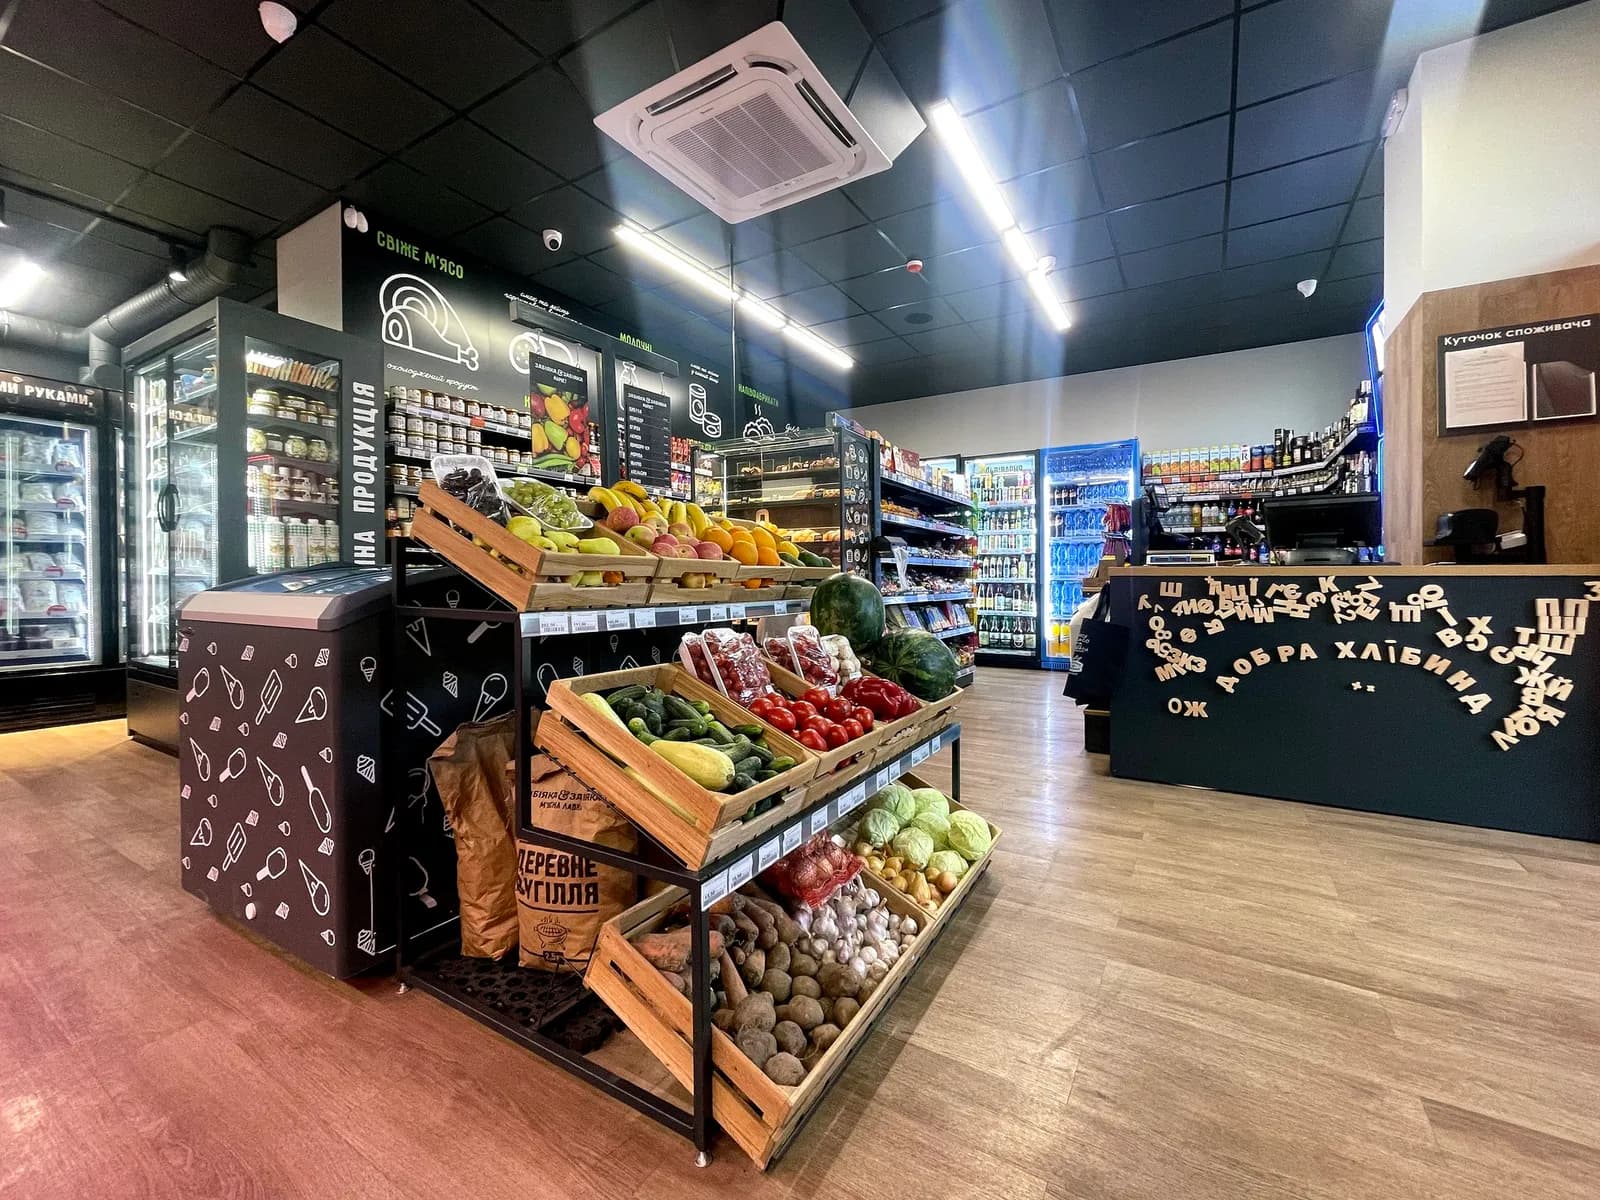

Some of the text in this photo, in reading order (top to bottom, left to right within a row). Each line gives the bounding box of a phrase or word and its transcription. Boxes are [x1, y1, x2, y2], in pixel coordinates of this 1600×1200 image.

[376, 230, 464, 280] СВІЖЕ М'ЯСО
[1444, 318, 1593, 347] Куточок споживача
[24, 384, 94, 408] РУКАМИ,
[352, 381, 379, 514] ПРОДУКЦІЯ
[1215, 642, 1319, 694] ДОБРА
